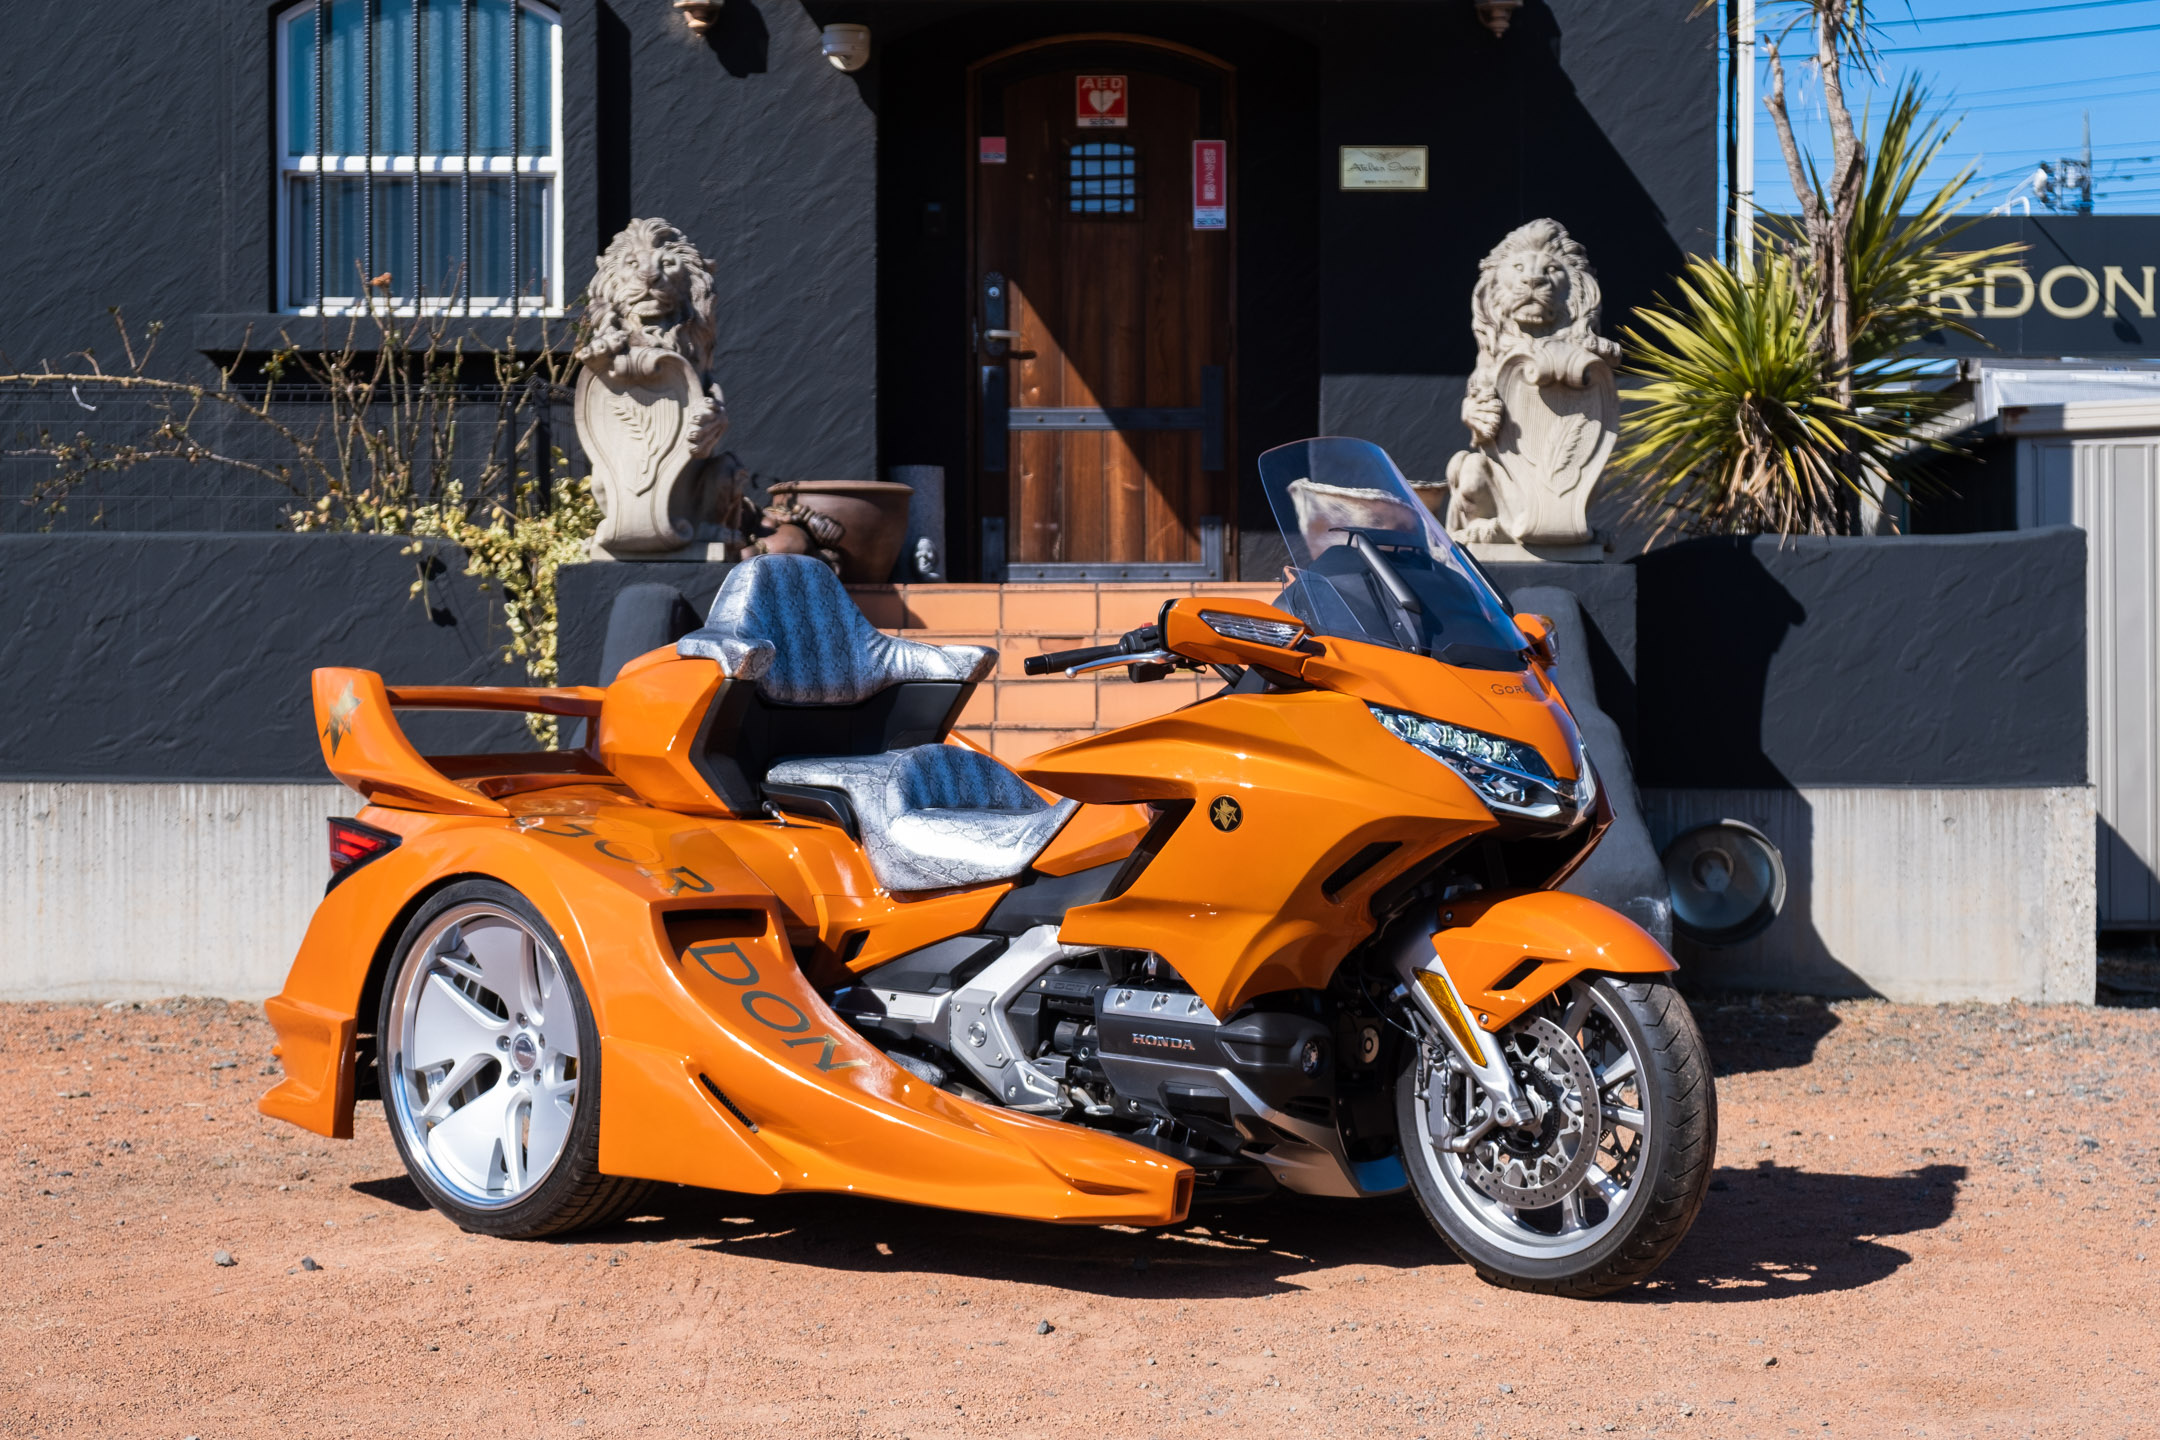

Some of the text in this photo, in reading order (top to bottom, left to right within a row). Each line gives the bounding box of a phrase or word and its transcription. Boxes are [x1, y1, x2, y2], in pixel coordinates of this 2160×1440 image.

[1081, 78, 1123, 89] AED
[1905, 264, 2157, 319] RDON
[1132, 1032, 1196, 1051] HONDA
